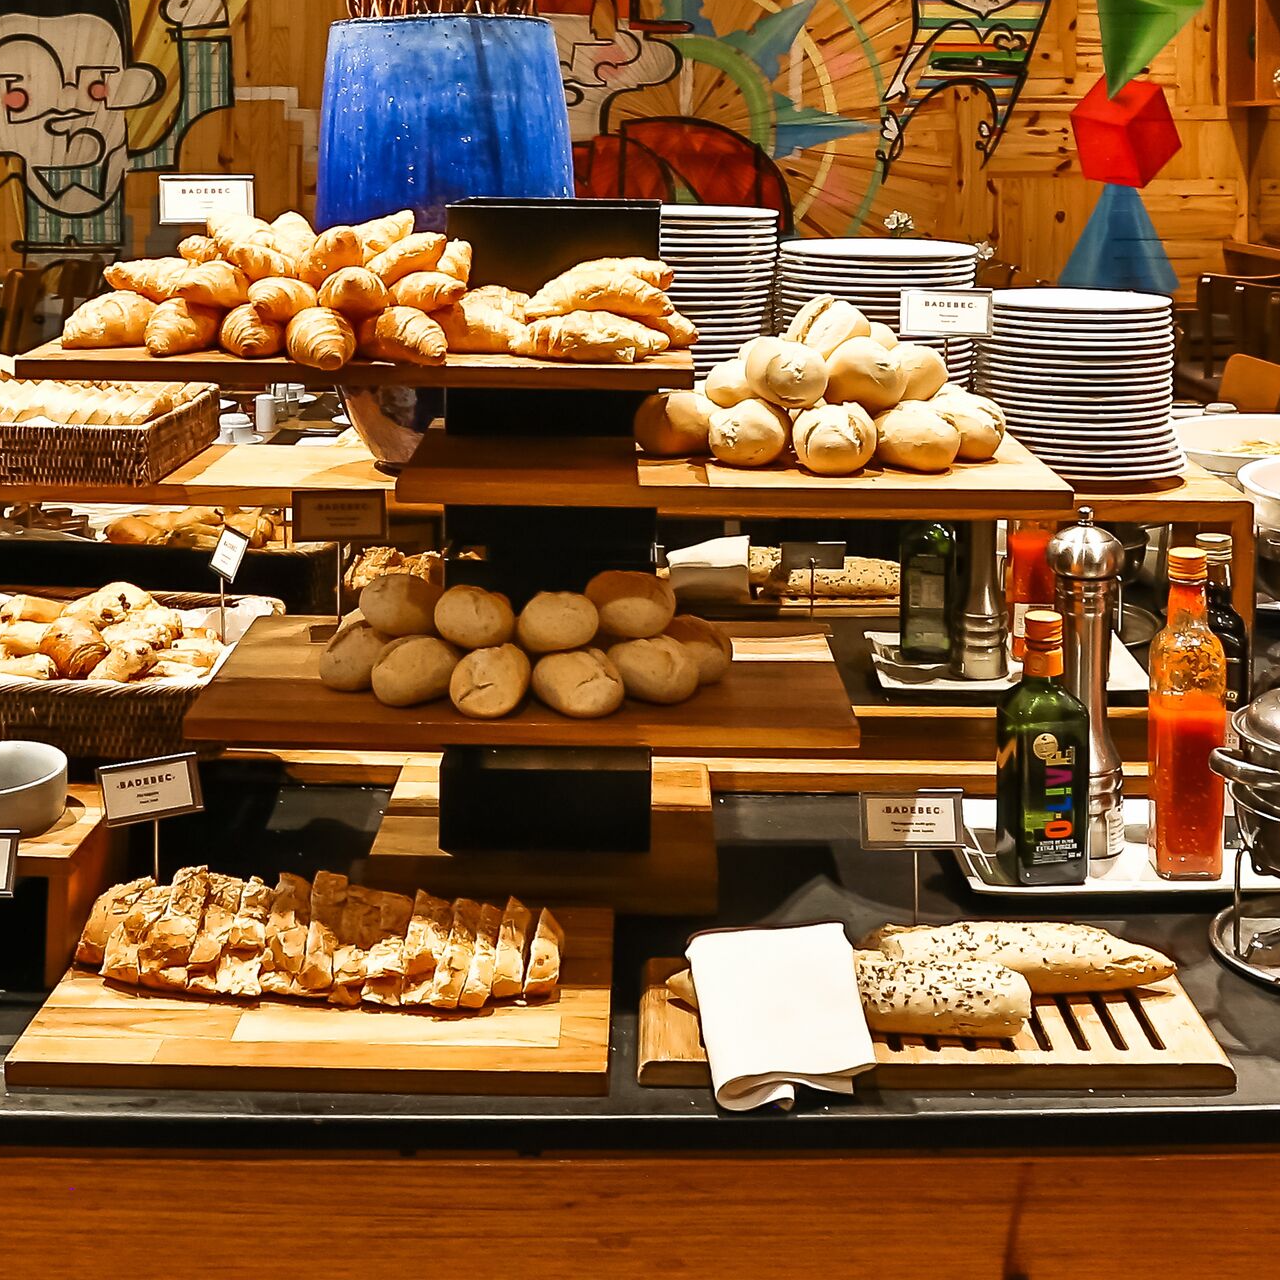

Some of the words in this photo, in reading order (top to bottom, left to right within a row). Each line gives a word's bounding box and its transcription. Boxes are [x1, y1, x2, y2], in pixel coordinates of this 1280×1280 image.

[924, 301, 974, 309] BADEBEC
[119, 773, 173, 789] BADEBEC
[885, 806, 940, 815] BADEBEC
